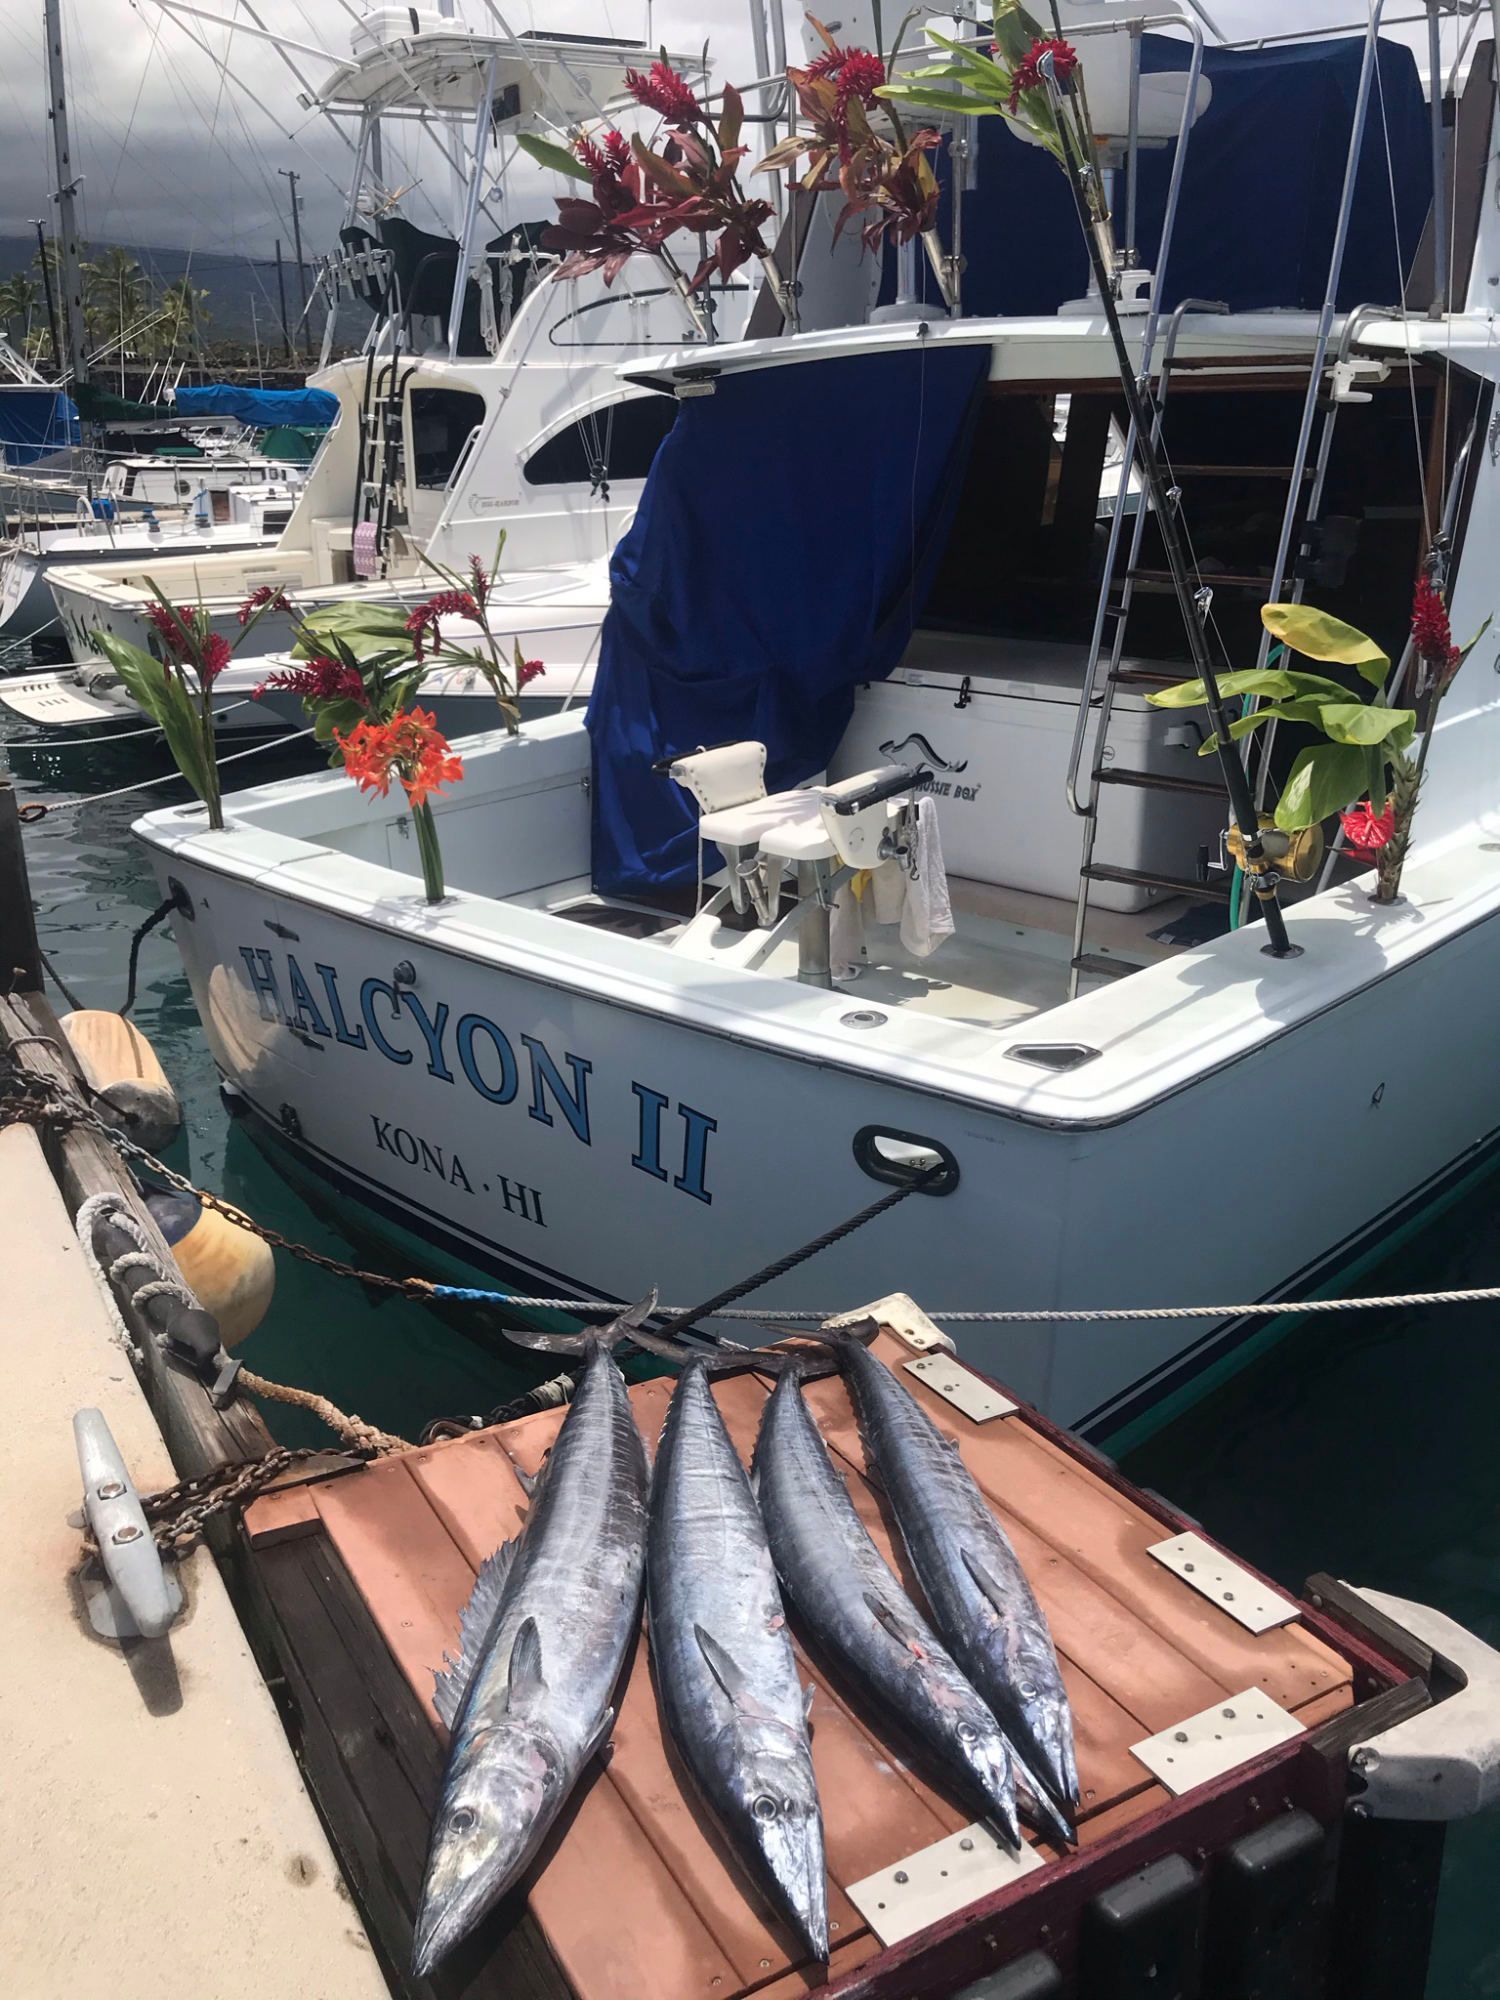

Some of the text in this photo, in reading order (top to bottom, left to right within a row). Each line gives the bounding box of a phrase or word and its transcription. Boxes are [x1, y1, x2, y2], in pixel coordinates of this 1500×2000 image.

[953, 784, 979, 802] BOX
[238, 945, 718, 1206] HALCYON II
[369, 1114, 548, 1228] KONA HI
